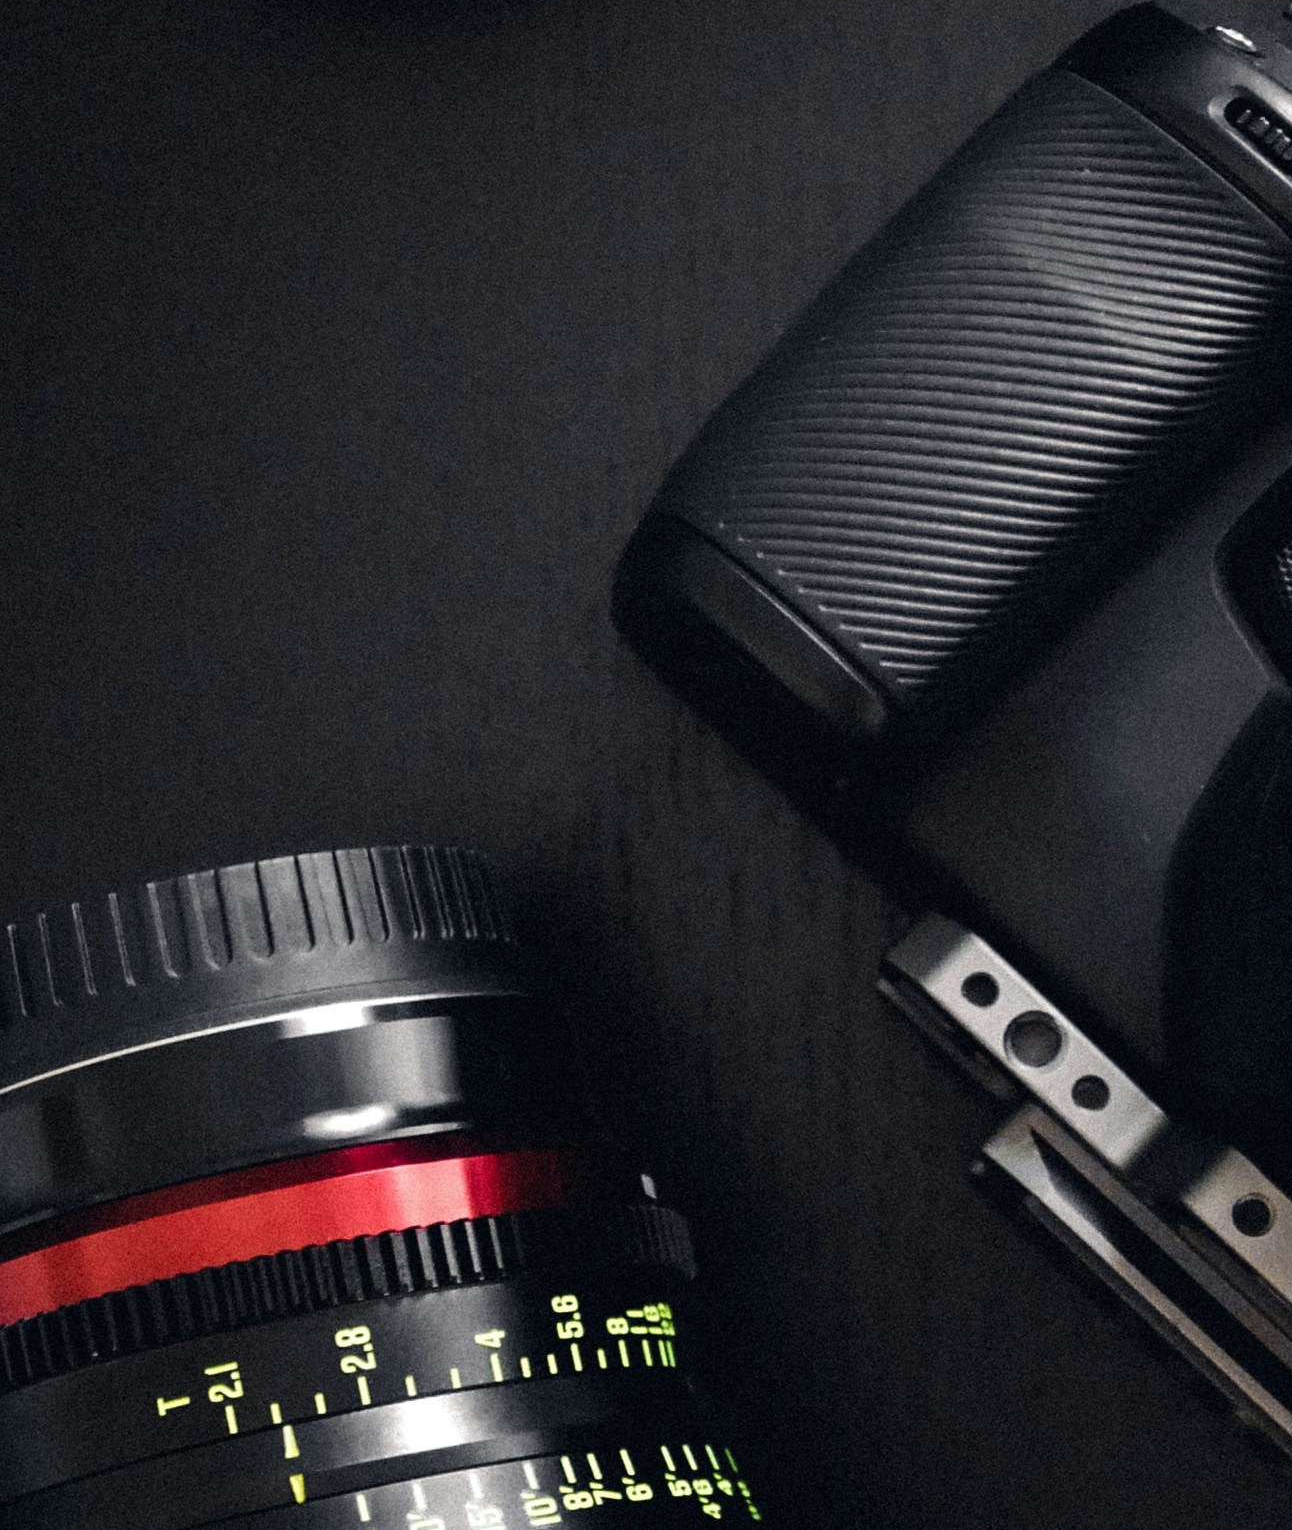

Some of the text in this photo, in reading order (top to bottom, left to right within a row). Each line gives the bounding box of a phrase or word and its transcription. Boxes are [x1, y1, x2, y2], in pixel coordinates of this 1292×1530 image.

[551, 1294, 585, 1340] 5.6
[606, 1317, 629, 1335] 8
[334, 1325, 377, 1374] 2.8
[473, 1328, 506, 1348] 4
[204, 1361, 244, 1403] 2.1
[156, 1396, 191, 1417] T
